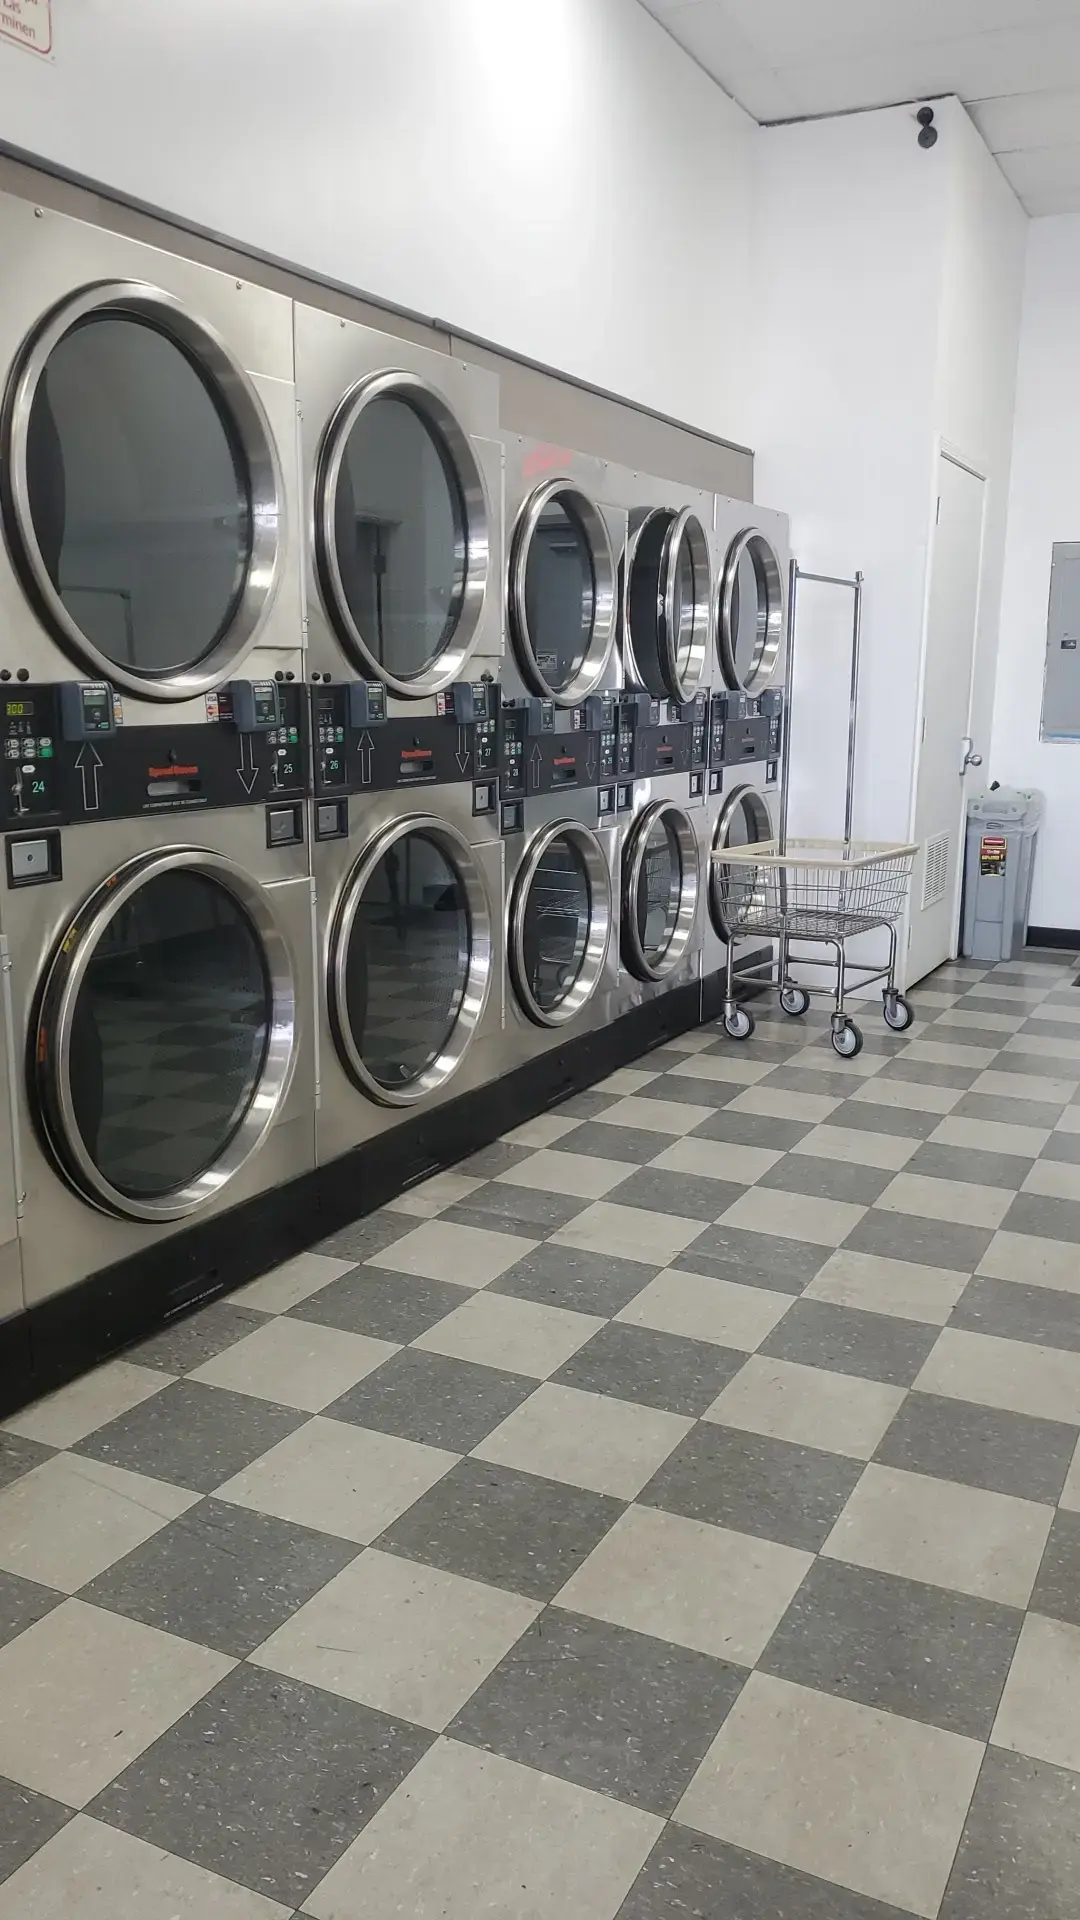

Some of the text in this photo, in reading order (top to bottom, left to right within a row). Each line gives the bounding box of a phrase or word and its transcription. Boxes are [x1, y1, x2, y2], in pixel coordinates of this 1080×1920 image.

[283, 763, 293, 774] 25
[330, 760, 339, 770] 26
[31, 780, 45, 793] 24
